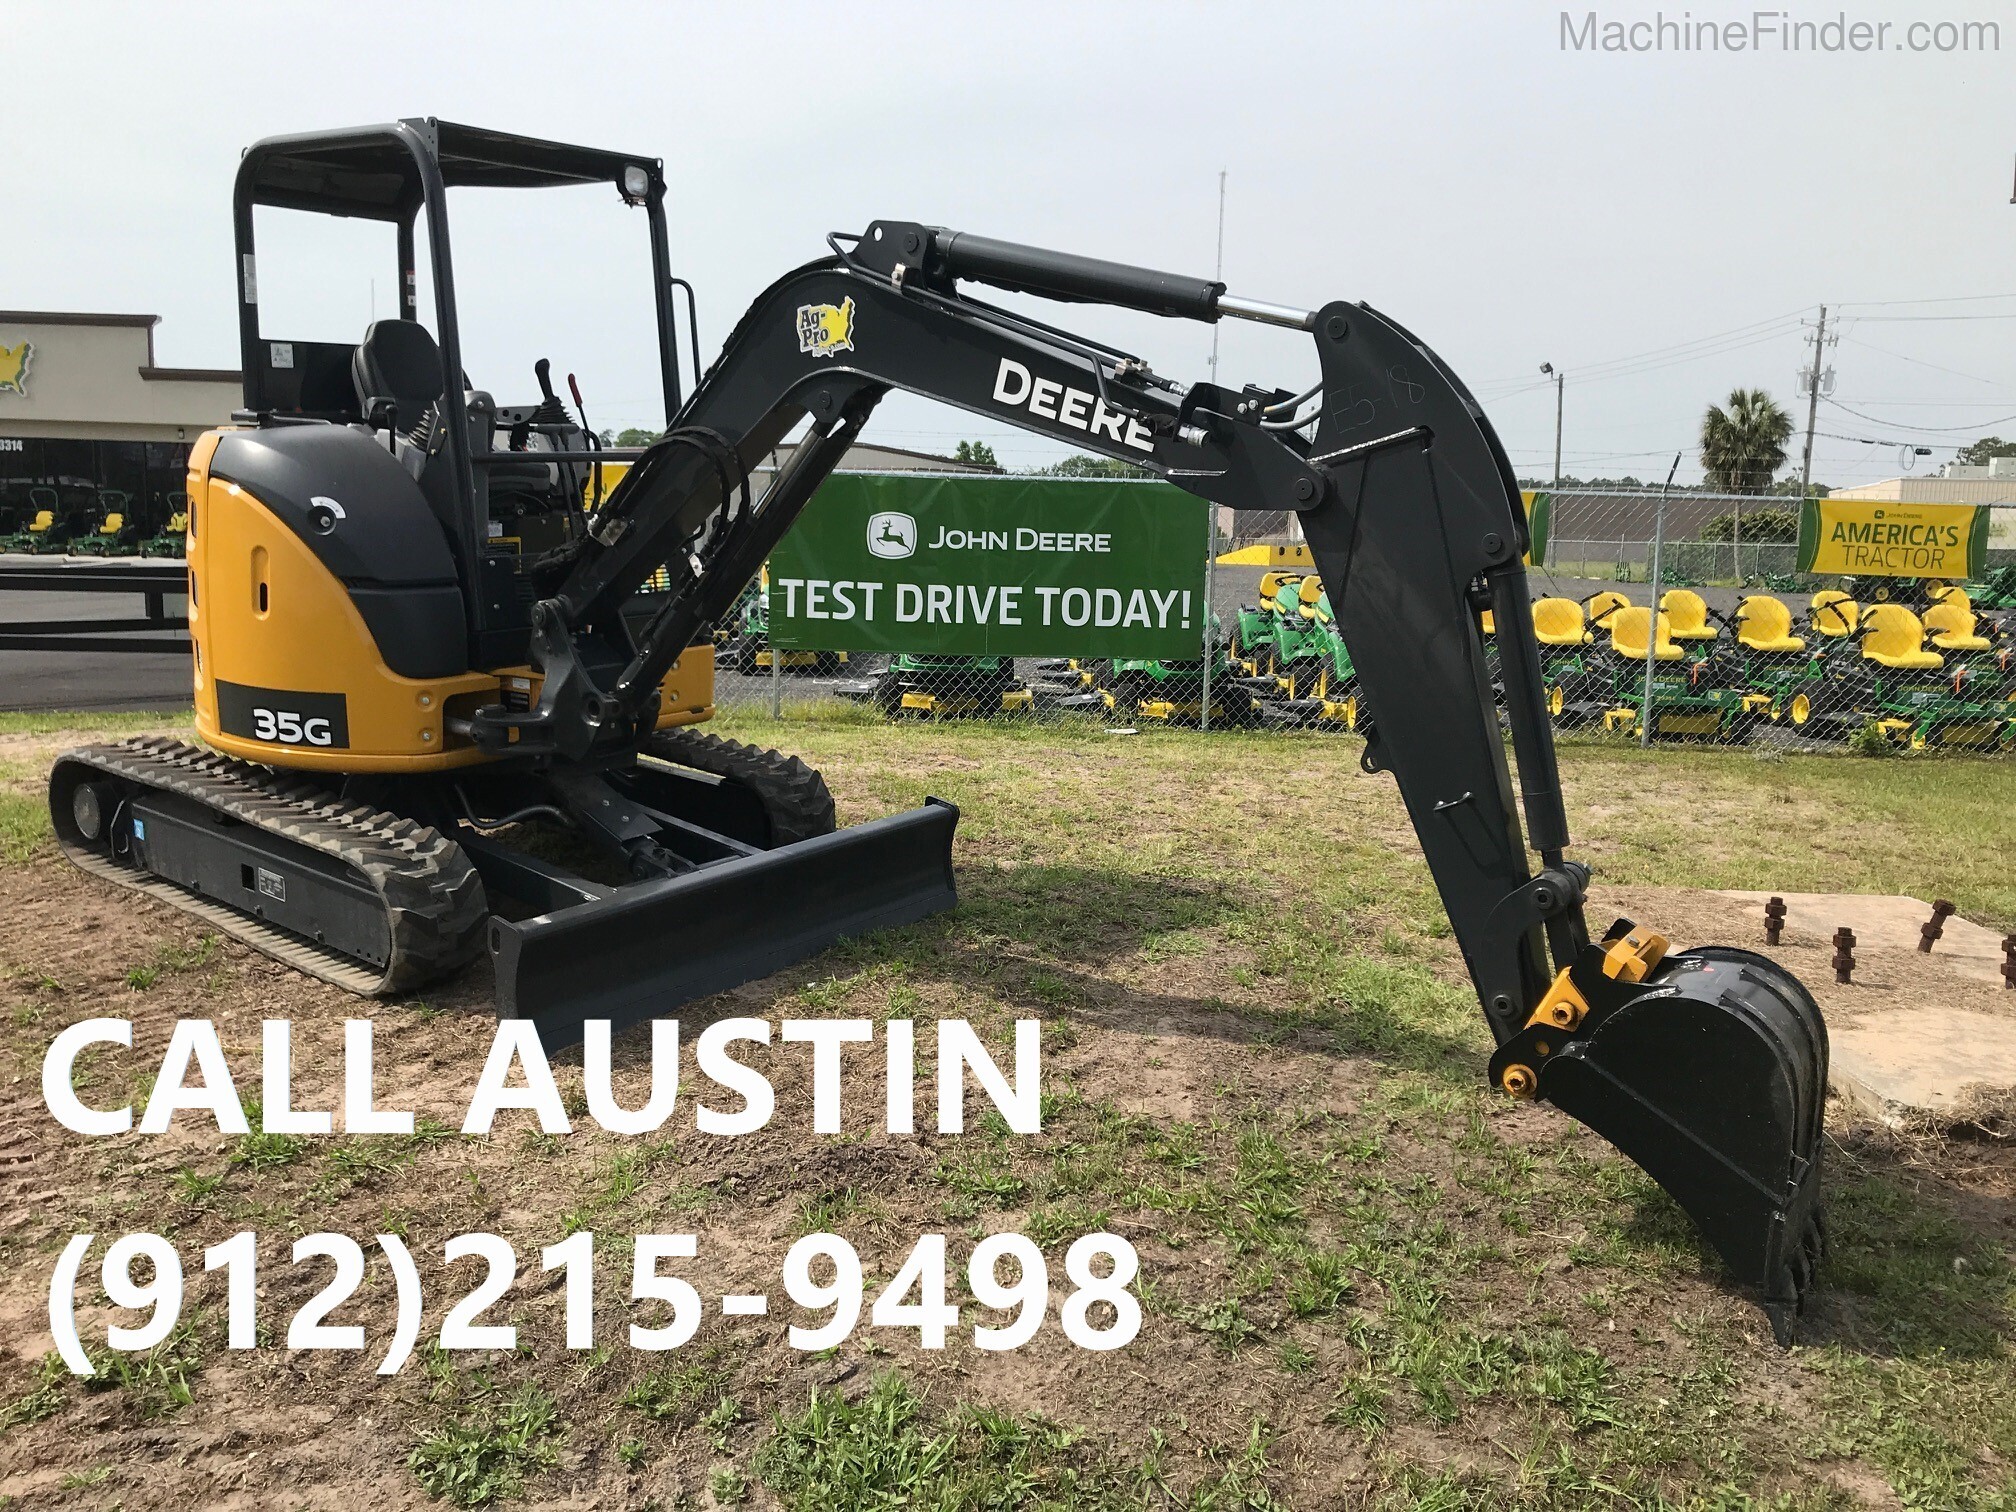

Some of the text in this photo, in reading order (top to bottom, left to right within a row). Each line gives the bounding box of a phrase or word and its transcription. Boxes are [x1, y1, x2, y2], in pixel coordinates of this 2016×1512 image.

[801, 309, 826, 330] Ag-
[801, 328, 829, 348] Pro
[992, 356, 1155, 453] DEERE
[928, 525, 1112, 553] JOHN DEERE
[1831, 521, 1959, 547] AMERICA'S
[1842, 545, 1946, 570] TRACTOR
[778, 578, 1192, 629] TEST DRIVE TODAY!
[253, 708, 332, 746] 35G
